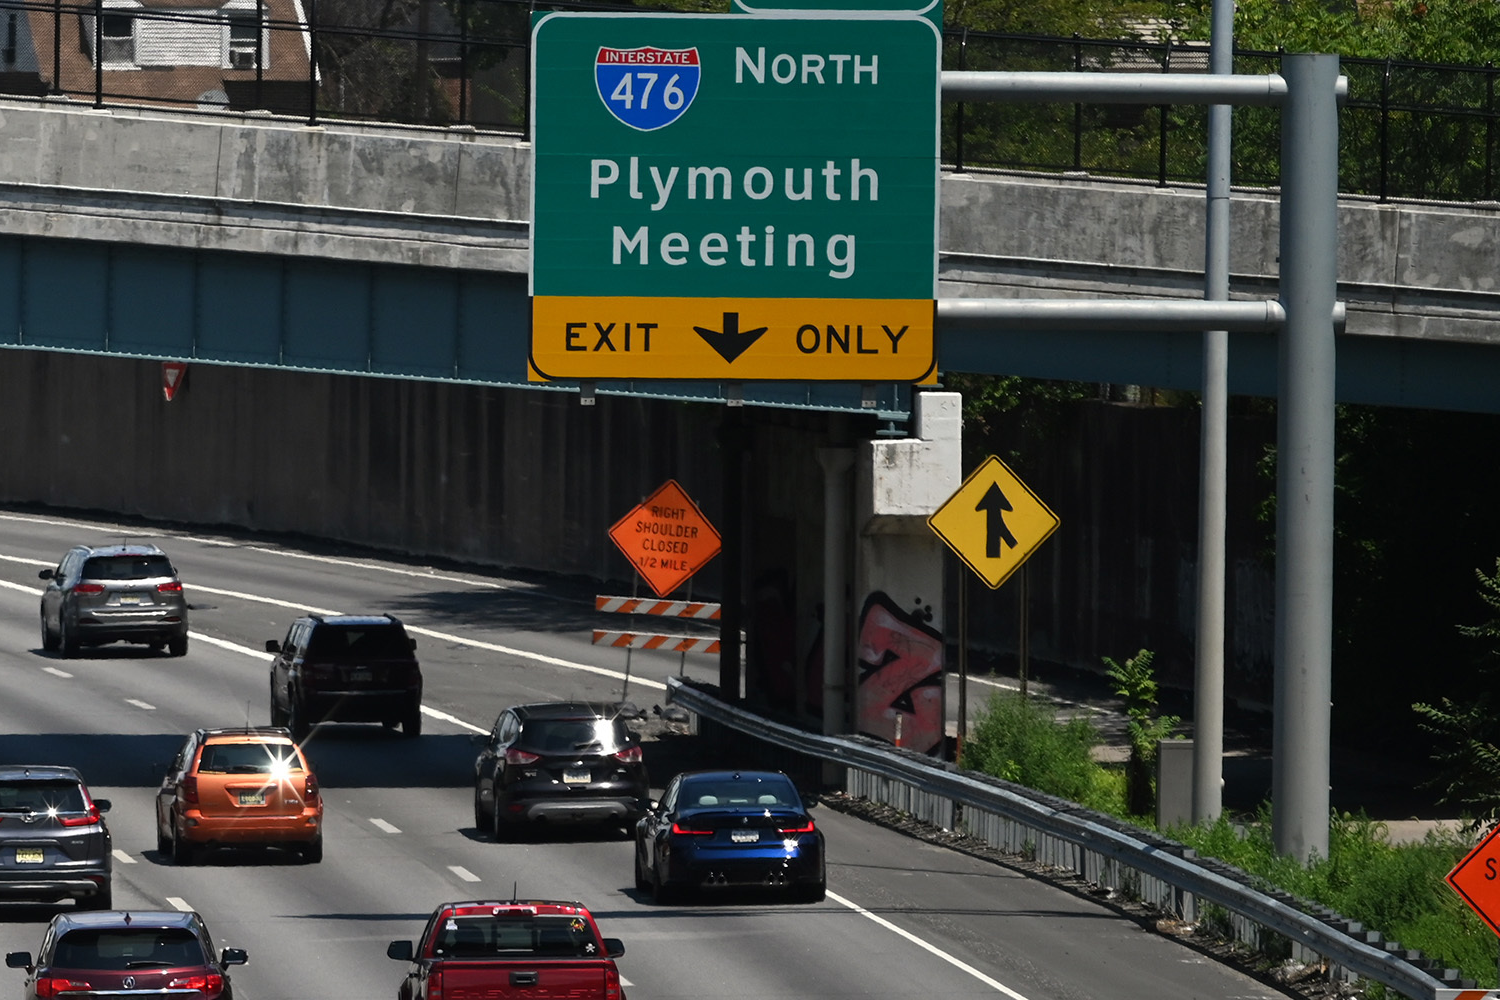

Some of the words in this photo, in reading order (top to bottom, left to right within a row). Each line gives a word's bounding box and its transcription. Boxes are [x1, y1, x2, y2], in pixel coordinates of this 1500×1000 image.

[605, 51, 690, 64] INTERSTATE
[611, 72, 684, 110] 476
[590, 156, 879, 211] Plymouth
[612, 225, 857, 279] Meeting
[565, 322, 658, 352] EXIT
[796, 324, 909, 354] ONLY
[651, 505, 686, 521] RIGHT
[635, 521, 698, 538] SHOULDER
[642, 538, 689, 554] CLOSED
[639, 556, 657, 569] 1/2
[660, 559, 688, 571] MILE
